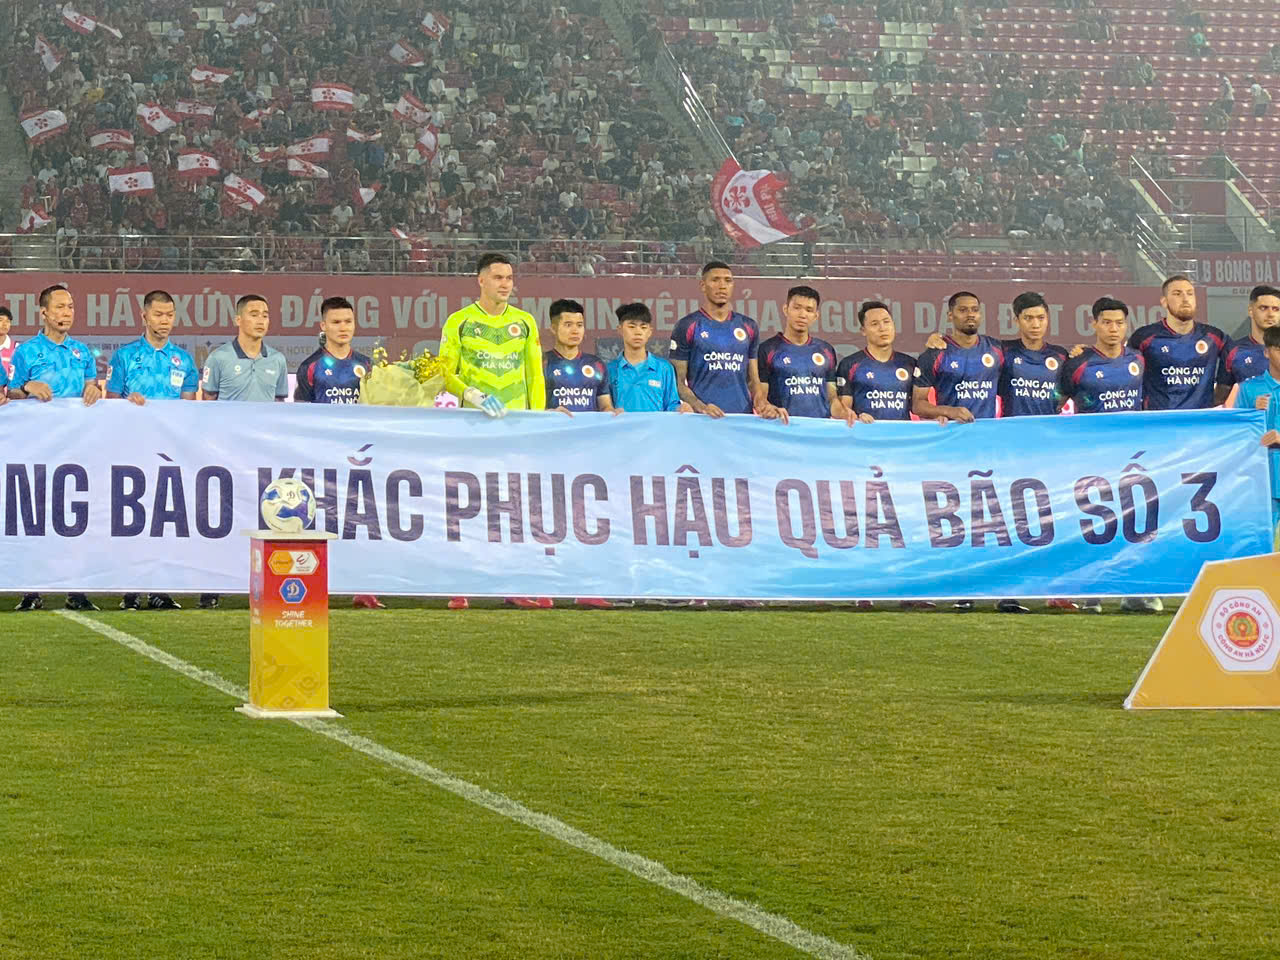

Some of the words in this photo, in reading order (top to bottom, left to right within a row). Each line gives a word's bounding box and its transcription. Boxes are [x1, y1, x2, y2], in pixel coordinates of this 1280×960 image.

[1216, 255, 1251, 282] BÓNG
[280, 288, 380, 329] ĐÁG
[477, 350, 503, 361] CÔNG
[506, 352, 518, 360] AN
[704, 351, 730, 361] CÔNG
[482, 359, 497, 369] HÀ
[499, 360, 515, 370] NỘI
[709, 360, 721, 370] HÀ
[723, 361, 741, 372] NỘI
[1161, 365, 1191, 375] CÔNG
[1192, 367, 1205, 375] AN
[785, 376, 811, 386] CÔNG
[812, 377, 823, 385] AN
[956, 380, 980, 391] CÔNG
[981, 381, 992, 389] AN
[1011, 377, 1040, 389] CÔNG
[1042, 382, 1055, 390] AN
[1167, 375, 1182, 385] HÀ
[1184, 375, 1200, 386] NỘI
[553, 386, 580, 397] CÔNG
[581, 388, 593, 396] AN
[790, 384, 804, 395] HÀ
[806, 385, 819, 395] NỘI
[866, 390, 894, 399] CÔNG
[957, 388, 971, 399] HÀ
[973, 389, 988, 400] NỘI
[1015, 387, 1030, 398] HÀ
[1033, 388, 1050, 400] NỘI
[1099, 389, 1124, 401] CÔNG
[1126, 389, 1138, 398] AN
[558, 396, 572, 406] HÀ
[574, 396, 589, 406] NỘI
[871, 398, 886, 409] HÀ
[887, 399, 904, 410] NỘI
[1103, 398, 1118, 410] HÀ
[1119, 398, 1135, 409] NỘI
[111, 453, 234, 540] BÀO
[444, 469, 611, 556] PHỤC
[629, 464, 753, 559] HẬU
[775, 465, 907, 559] QUẢ
[921, 469, 1055, 549] BÃO
[1073, 450, 1159, 545] SỐ
[1180, 471, 1220, 543] 3
[282, 610, 304, 619] SHINE
[275, 619, 313, 628] TOGETHER
